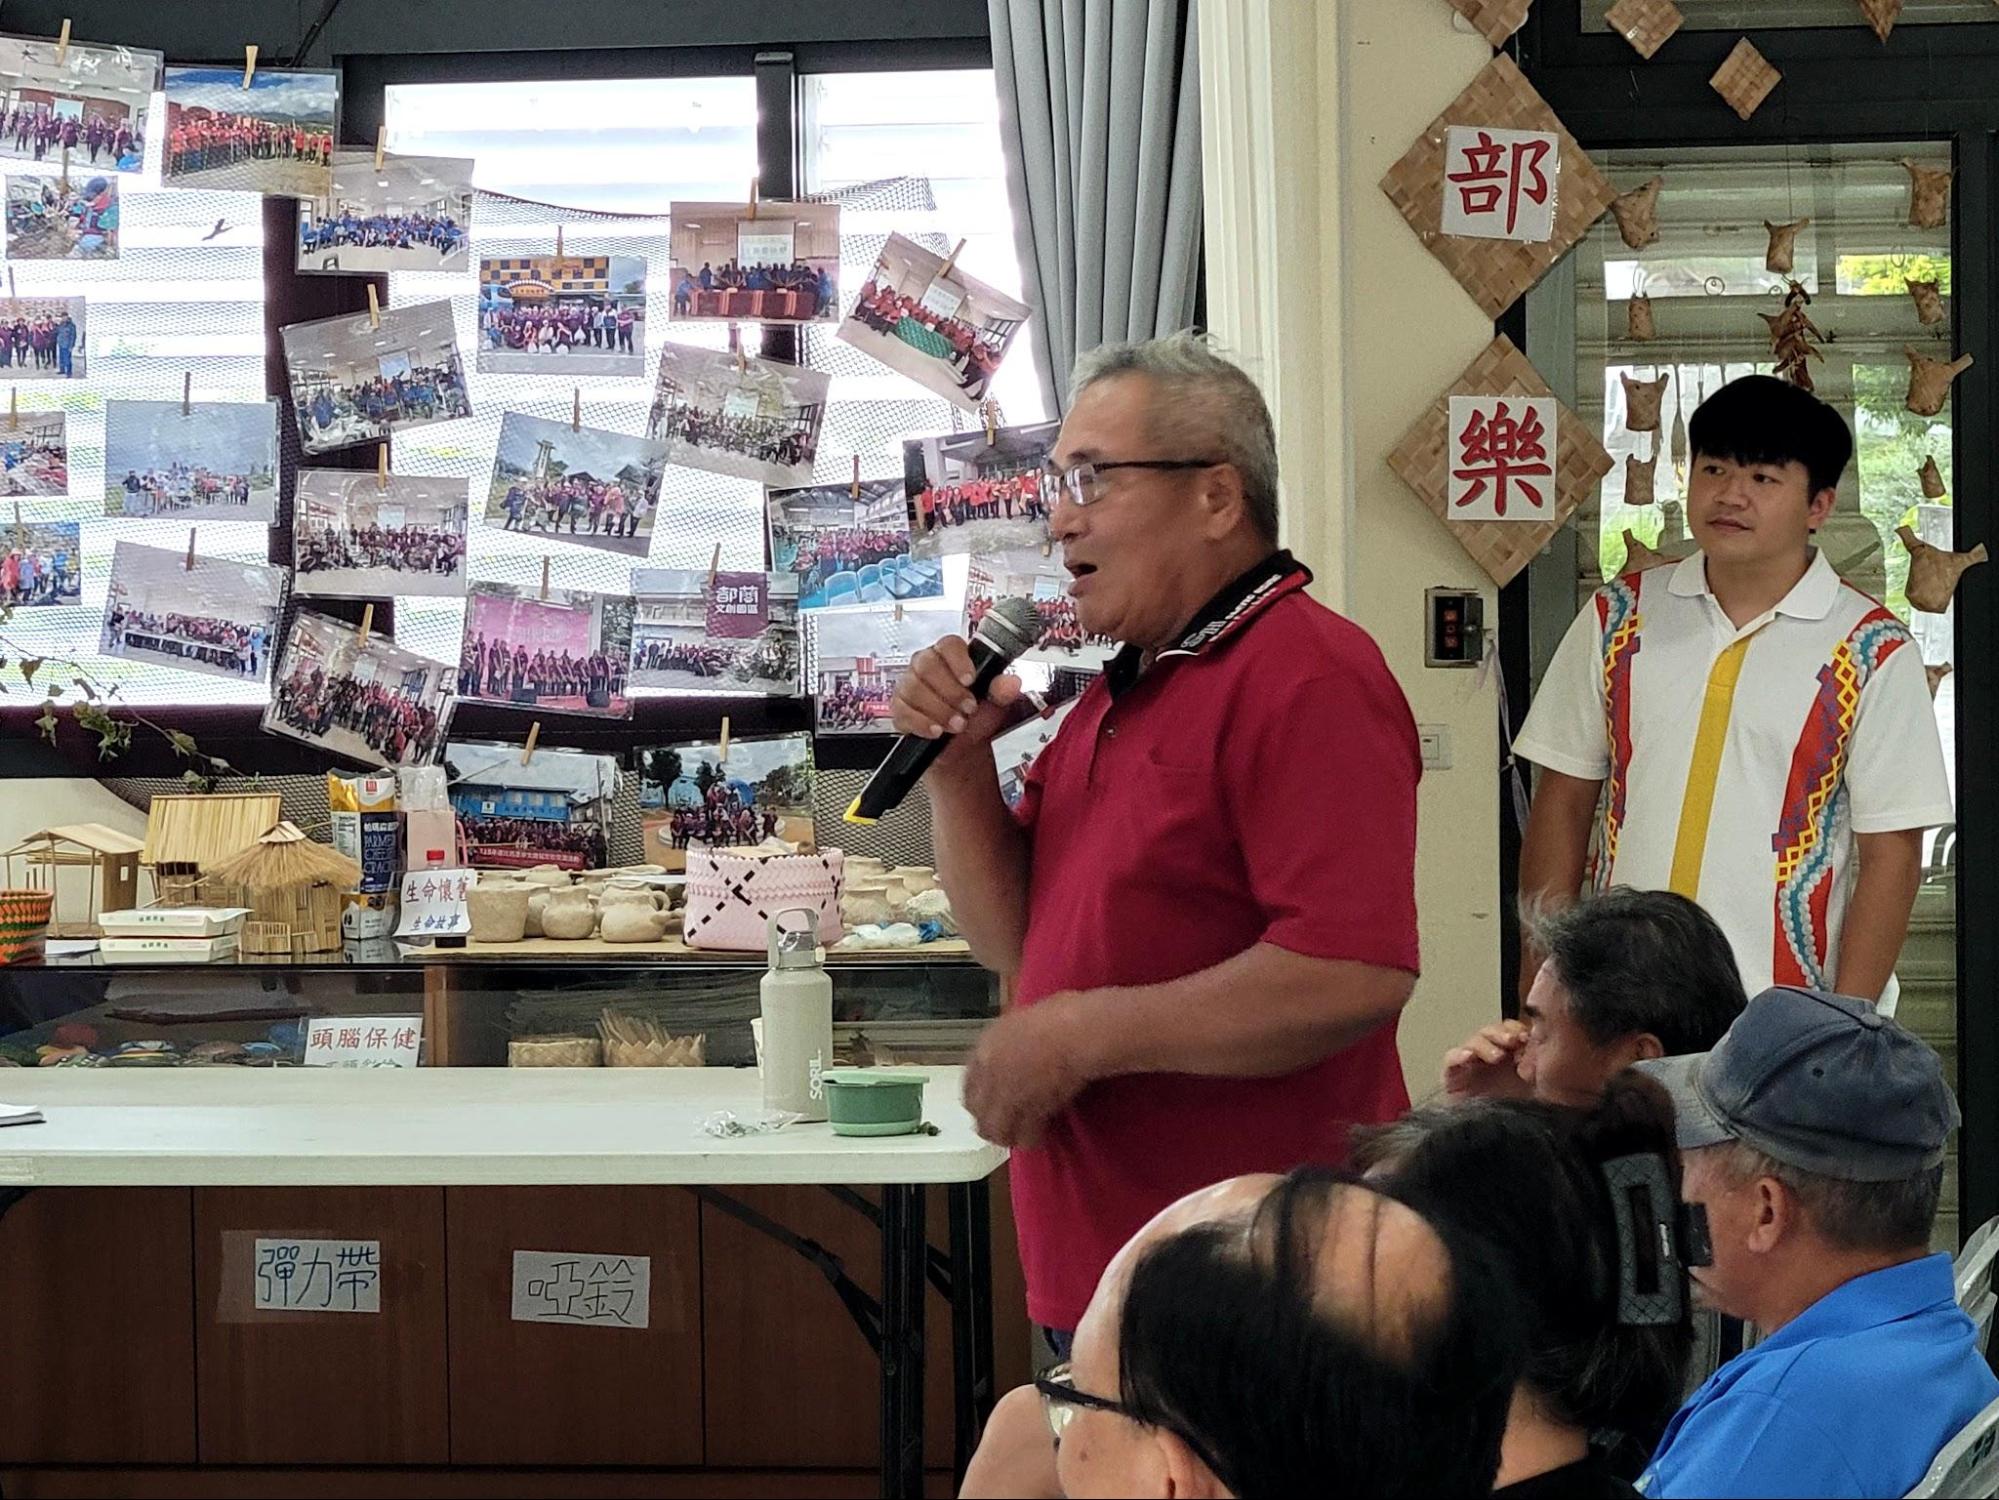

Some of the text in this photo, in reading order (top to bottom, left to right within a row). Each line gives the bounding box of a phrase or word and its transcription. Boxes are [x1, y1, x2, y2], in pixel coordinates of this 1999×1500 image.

[1447, 131, 1551, 235] 部
[1453, 401, 1553, 517] 樂
[309, 1026, 417, 1051] 頭腦保健
[257, 1245, 381, 1311] 彈力帶
[527, 1258, 636, 1326] 啞鈴
